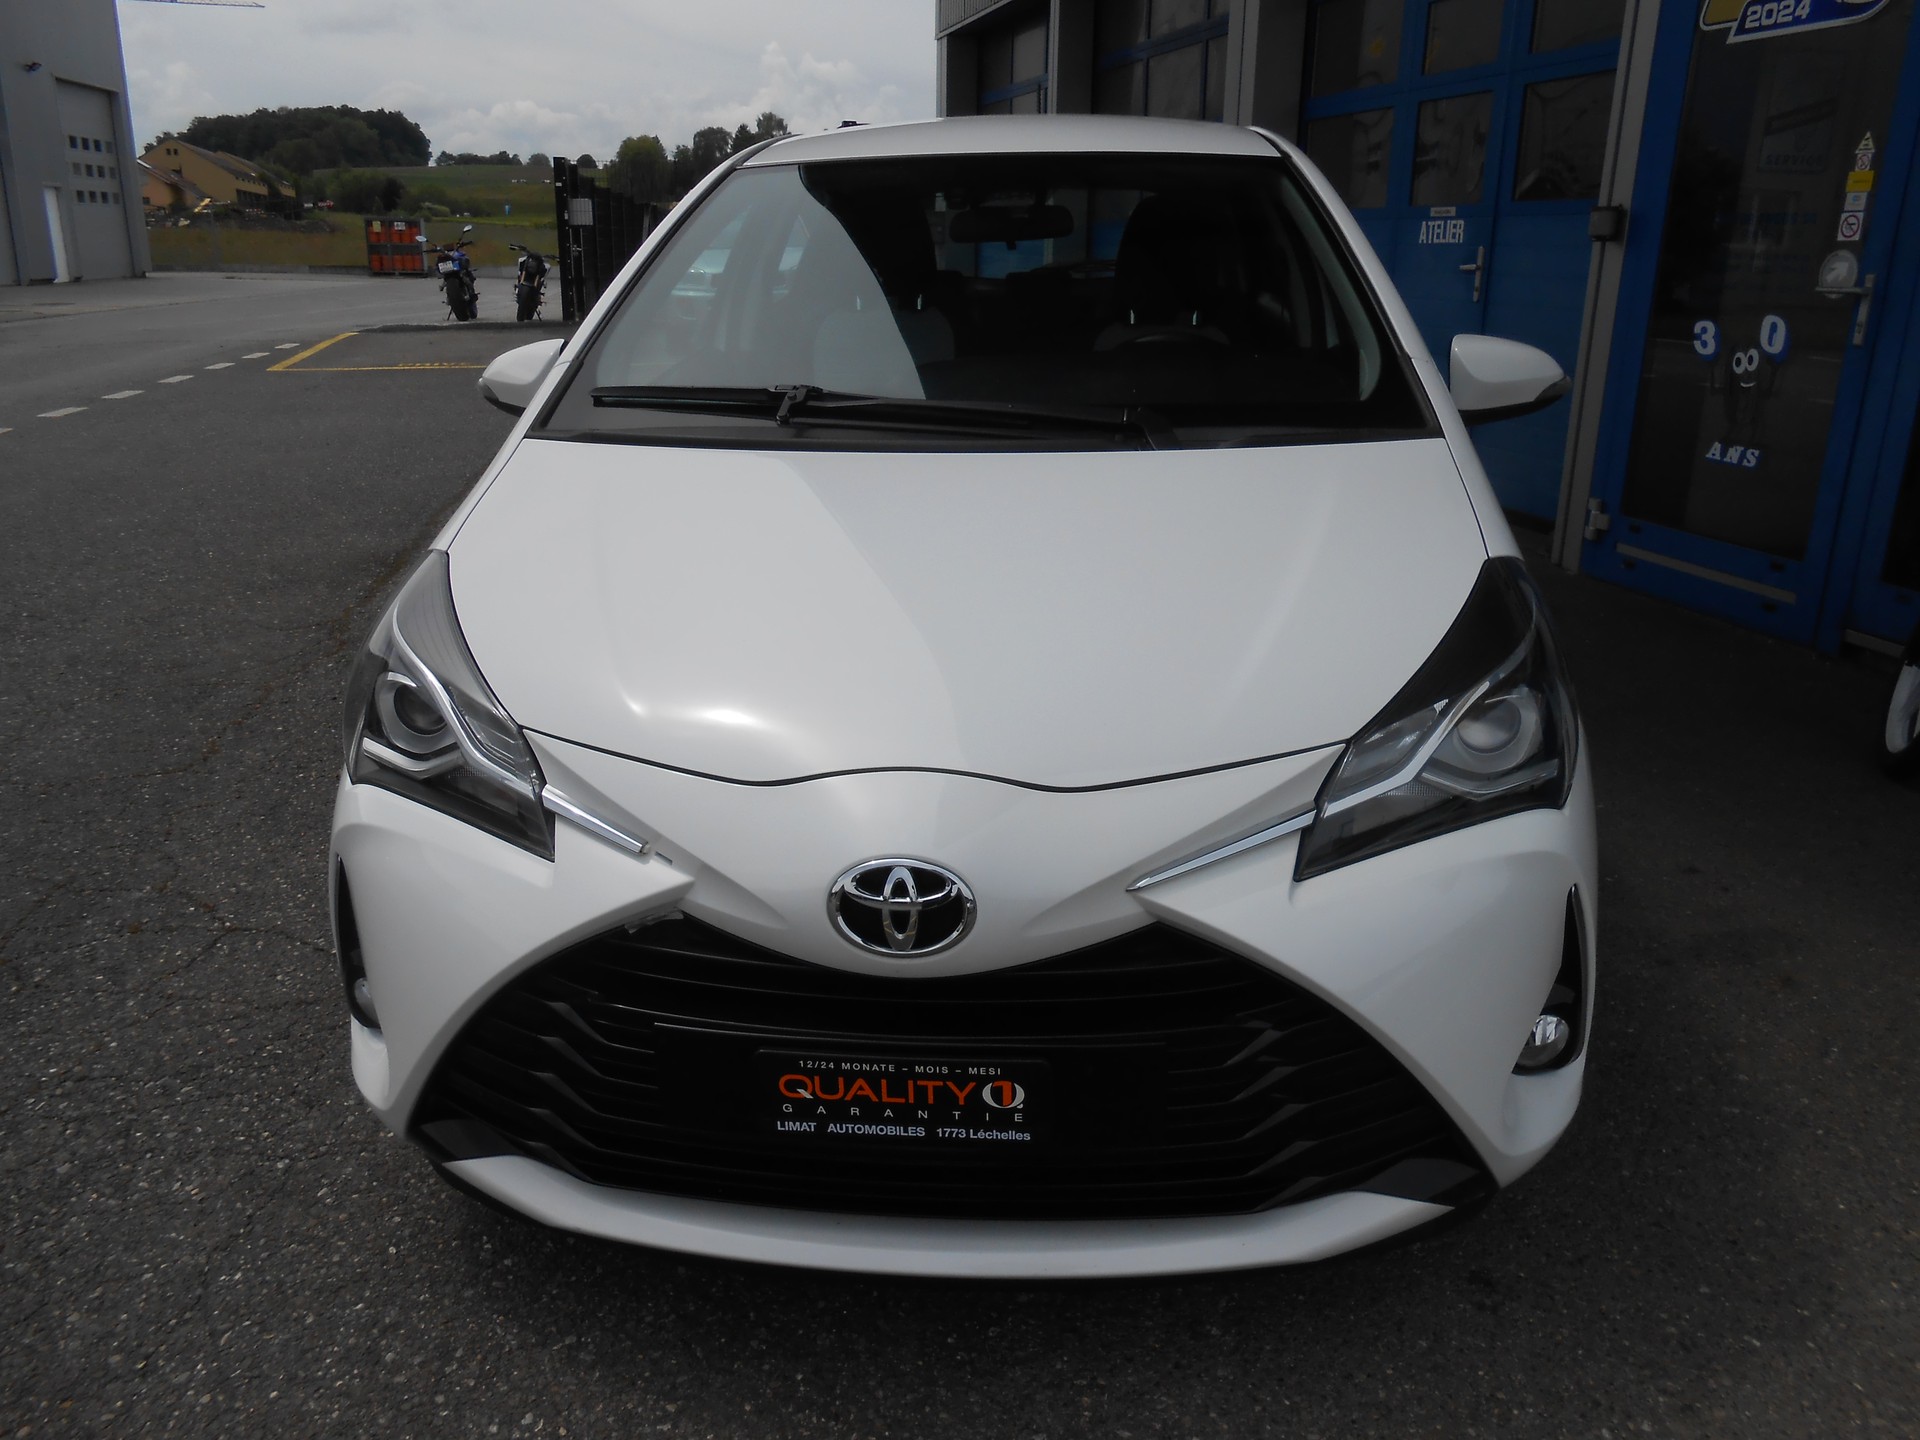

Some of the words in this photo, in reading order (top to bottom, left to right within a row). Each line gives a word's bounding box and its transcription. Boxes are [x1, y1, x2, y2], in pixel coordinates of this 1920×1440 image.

[1744, 0, 1811, 29] 2024
[1418, 219, 1465, 244] ATELIER
[1705, 441, 1760, 468] ANS
[798, 1060, 835, 1069] 12/24
[841, 1062, 896, 1072] MONATE
[915, 1065, 949, 1074] MOIS
[968, 1067, 1001, 1076] MESI
[778, 1074, 977, 1106] QUALITY
[782, 1103, 1023, 1122] GARANTIE
[776, 1120, 817, 1132] LIMAT
[827, 1123, 926, 1137] AUTOMOBILES
[936, 1127, 967, 1139] 1773
[969, 1128, 1031, 1141] Léchelles
